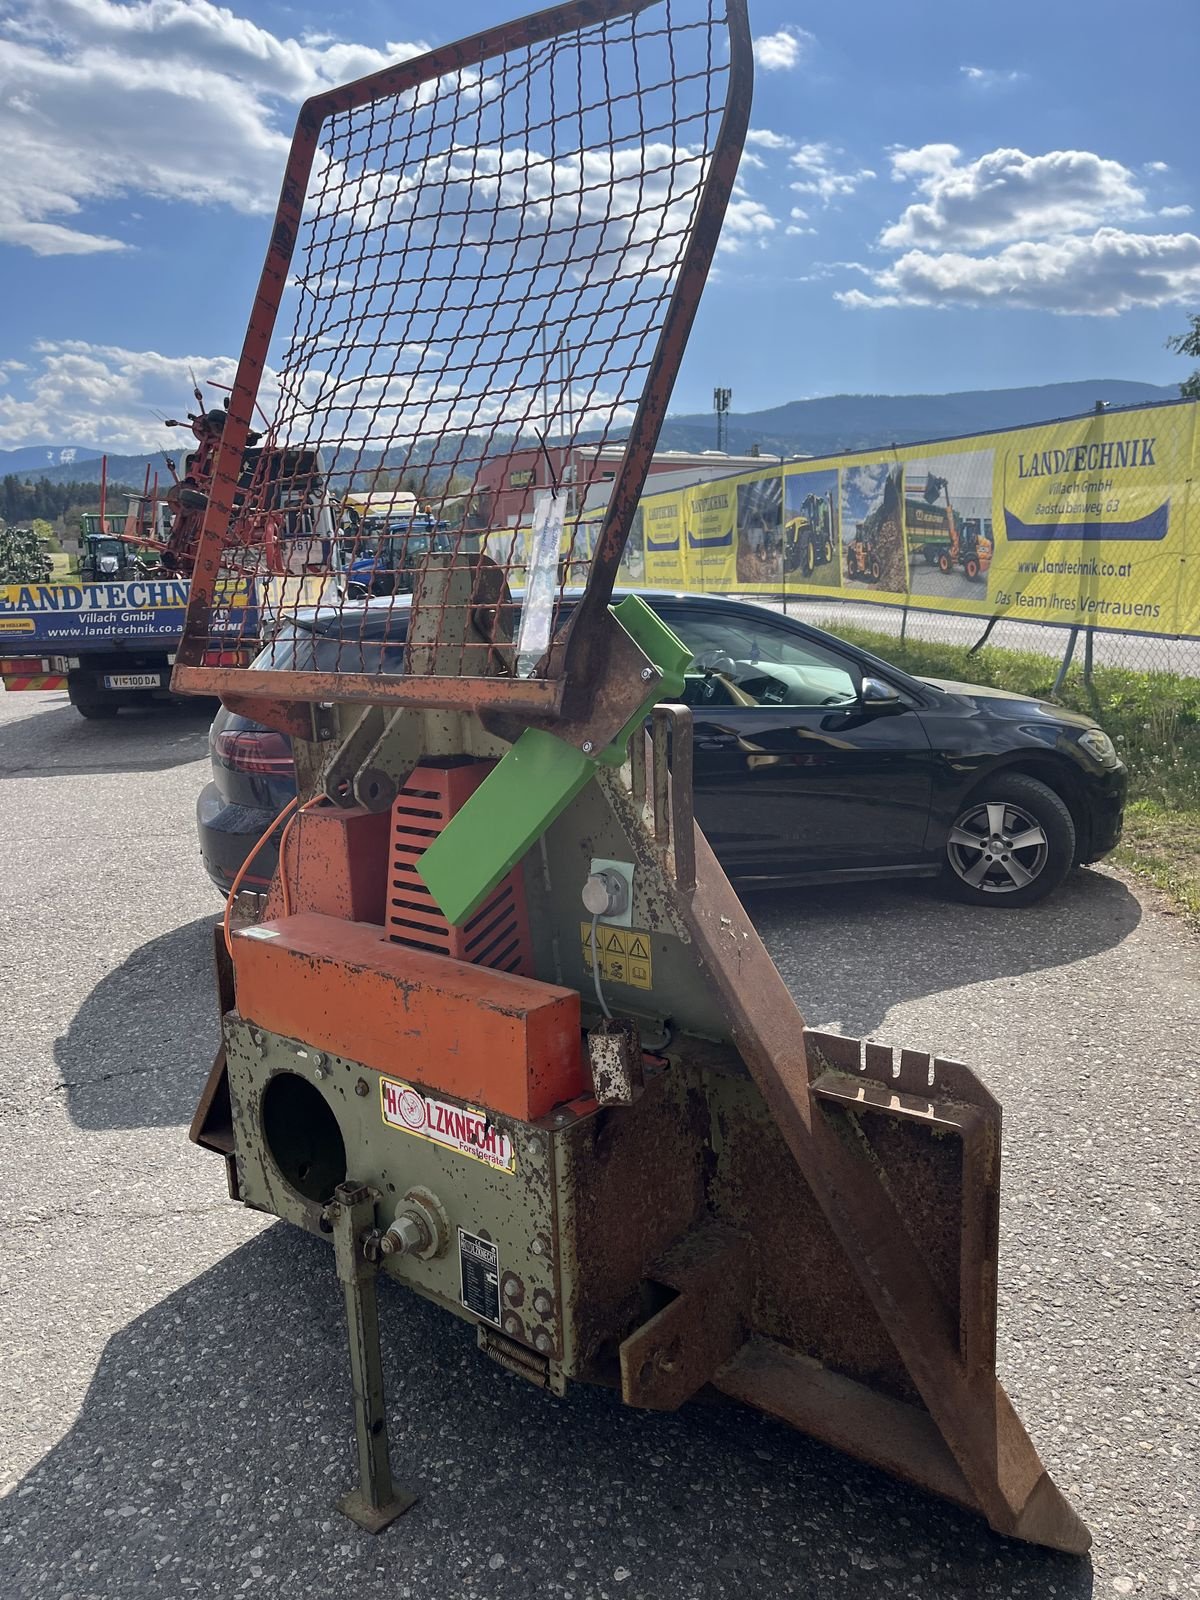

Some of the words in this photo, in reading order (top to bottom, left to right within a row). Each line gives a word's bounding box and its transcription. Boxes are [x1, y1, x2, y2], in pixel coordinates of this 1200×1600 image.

[1018, 438, 1156, 479] LANDTECHNIK
[1048, 481, 1080, 496] Villach
[1081, 479, 1112, 493] GmbH
[1106, 500, 1119, 513] 63
[1018, 557, 1132, 577] www.landtechnik.co.at
[994, 590, 1011, 605] Das
[1015, 592, 1047, 608] Team
[1050, 593, 1077, 611] Ihres
[1080, 596, 1161, 618] Vertrauens
[78, 613, 117, 624] Villach
[121, 611, 155, 622] GmbH
[48, 624, 183, 637] www.landtechnik.co.a
[459, 1141, 504, 1167] Forstgeräte
